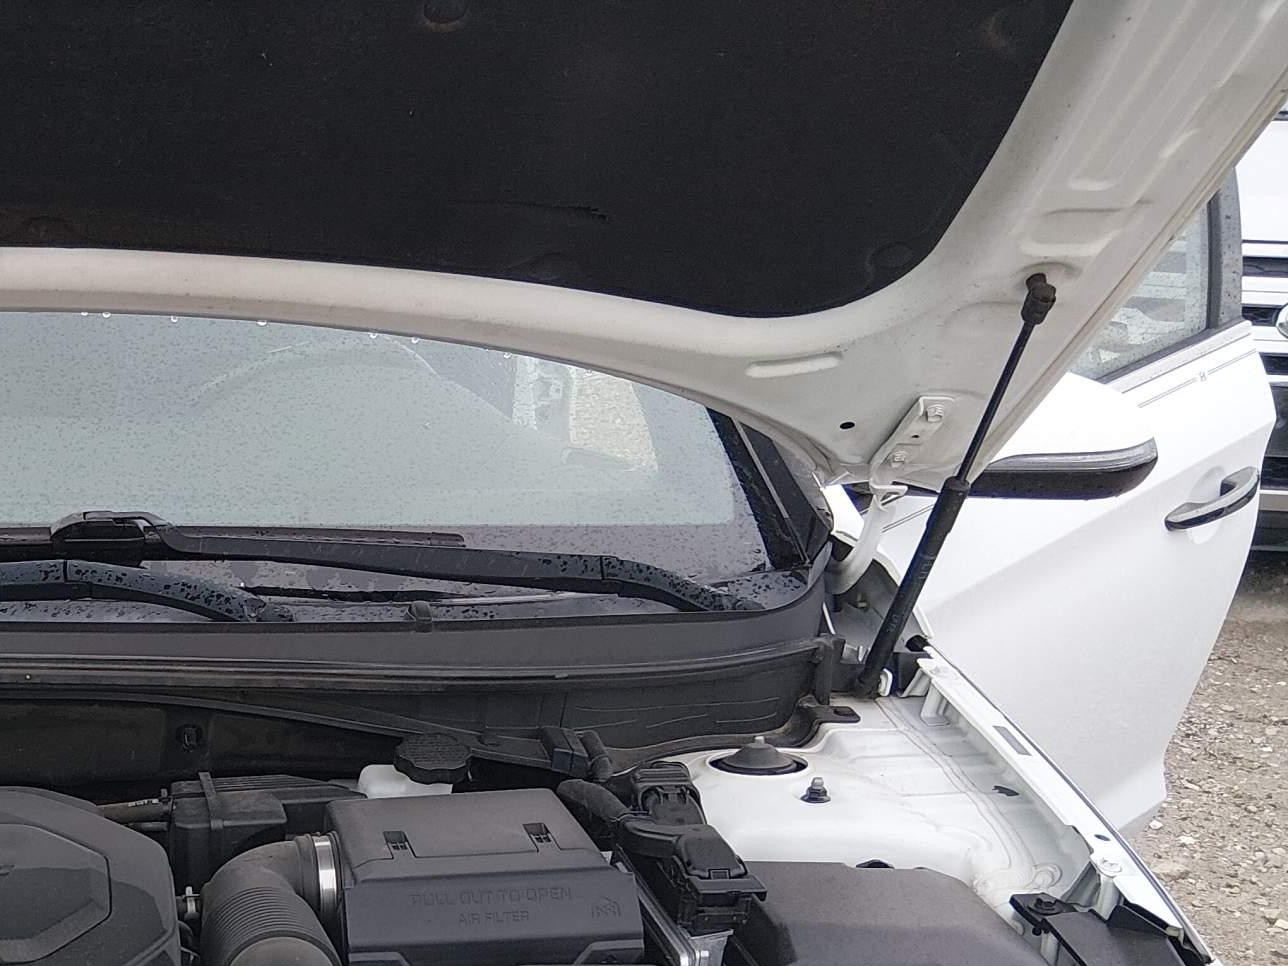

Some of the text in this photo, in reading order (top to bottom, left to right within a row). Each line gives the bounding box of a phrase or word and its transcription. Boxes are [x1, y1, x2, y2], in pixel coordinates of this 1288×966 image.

[460, 890, 493, 905] OUT
[495, 889, 521, 903] TO
[525, 887, 573, 901] OPEN
[459, 910, 530, 927] AIR FILTER
